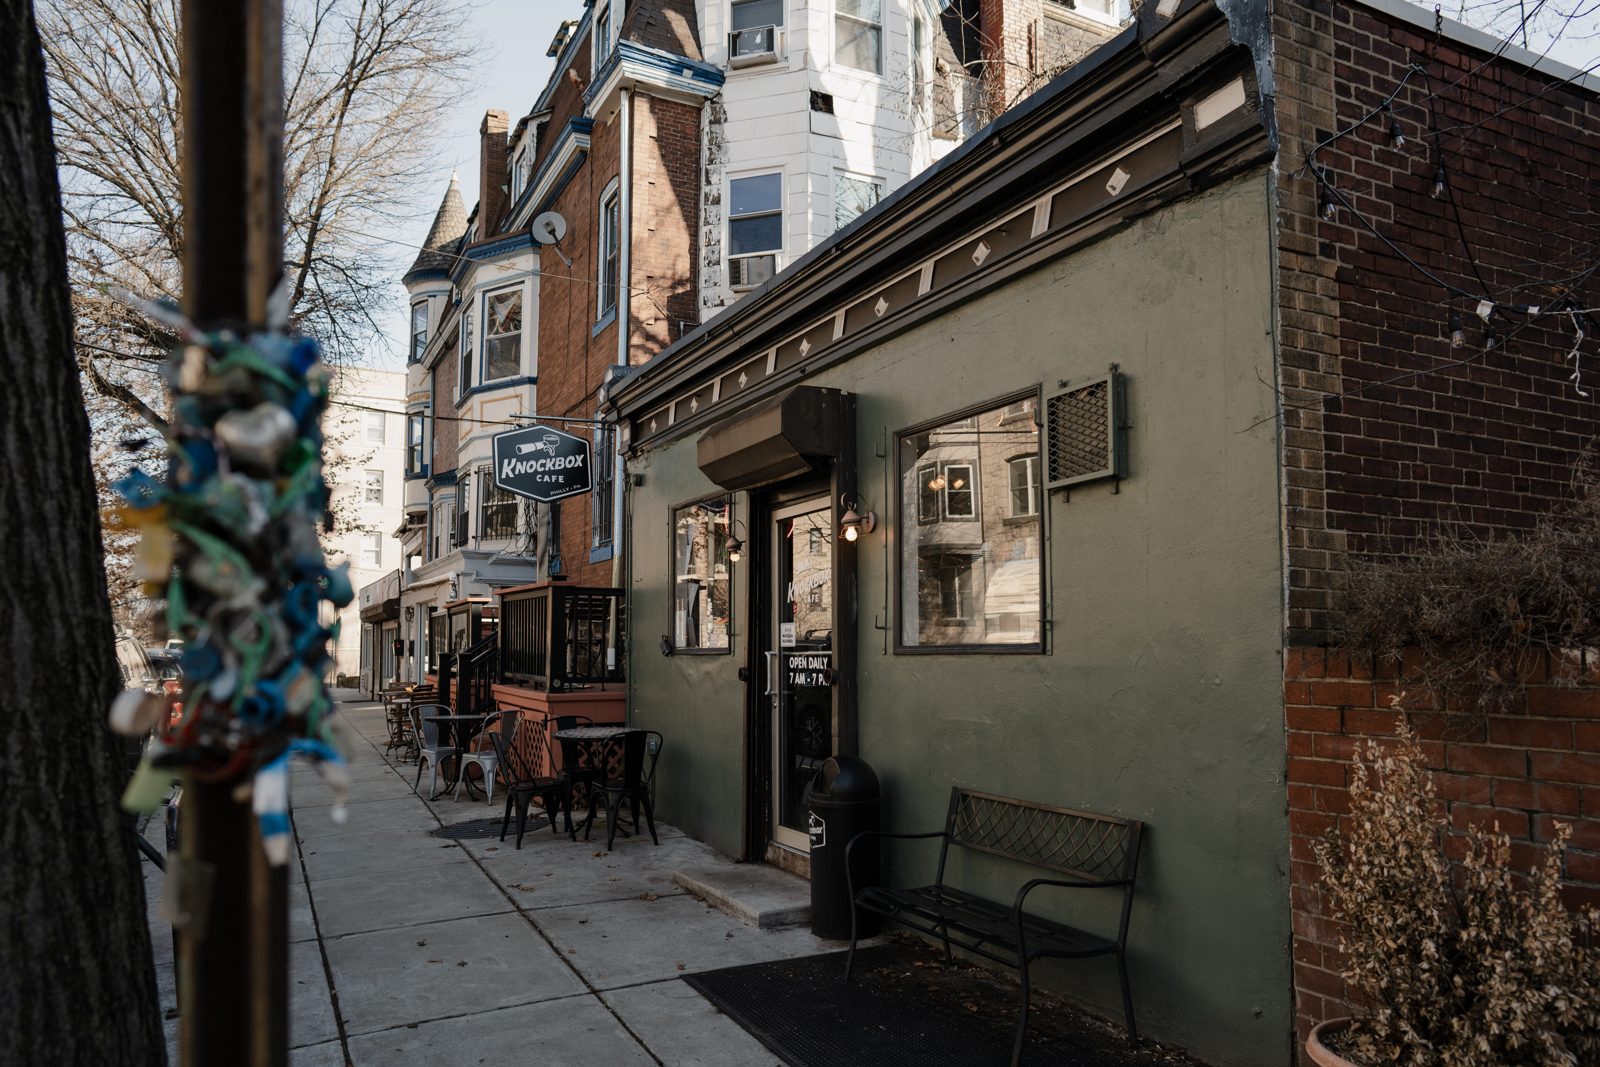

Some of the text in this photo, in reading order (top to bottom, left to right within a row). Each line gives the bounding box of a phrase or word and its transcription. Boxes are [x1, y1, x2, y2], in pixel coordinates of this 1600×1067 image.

[501, 454, 585, 479] KNOCKBOX
[536, 475, 564, 483] CAFE
[789, 656, 828, 671] OPEN DAILY
[789, 672, 794, 684] 7
[795, 672, 806, 685] AM
[812, 673, 817, 685] 7
